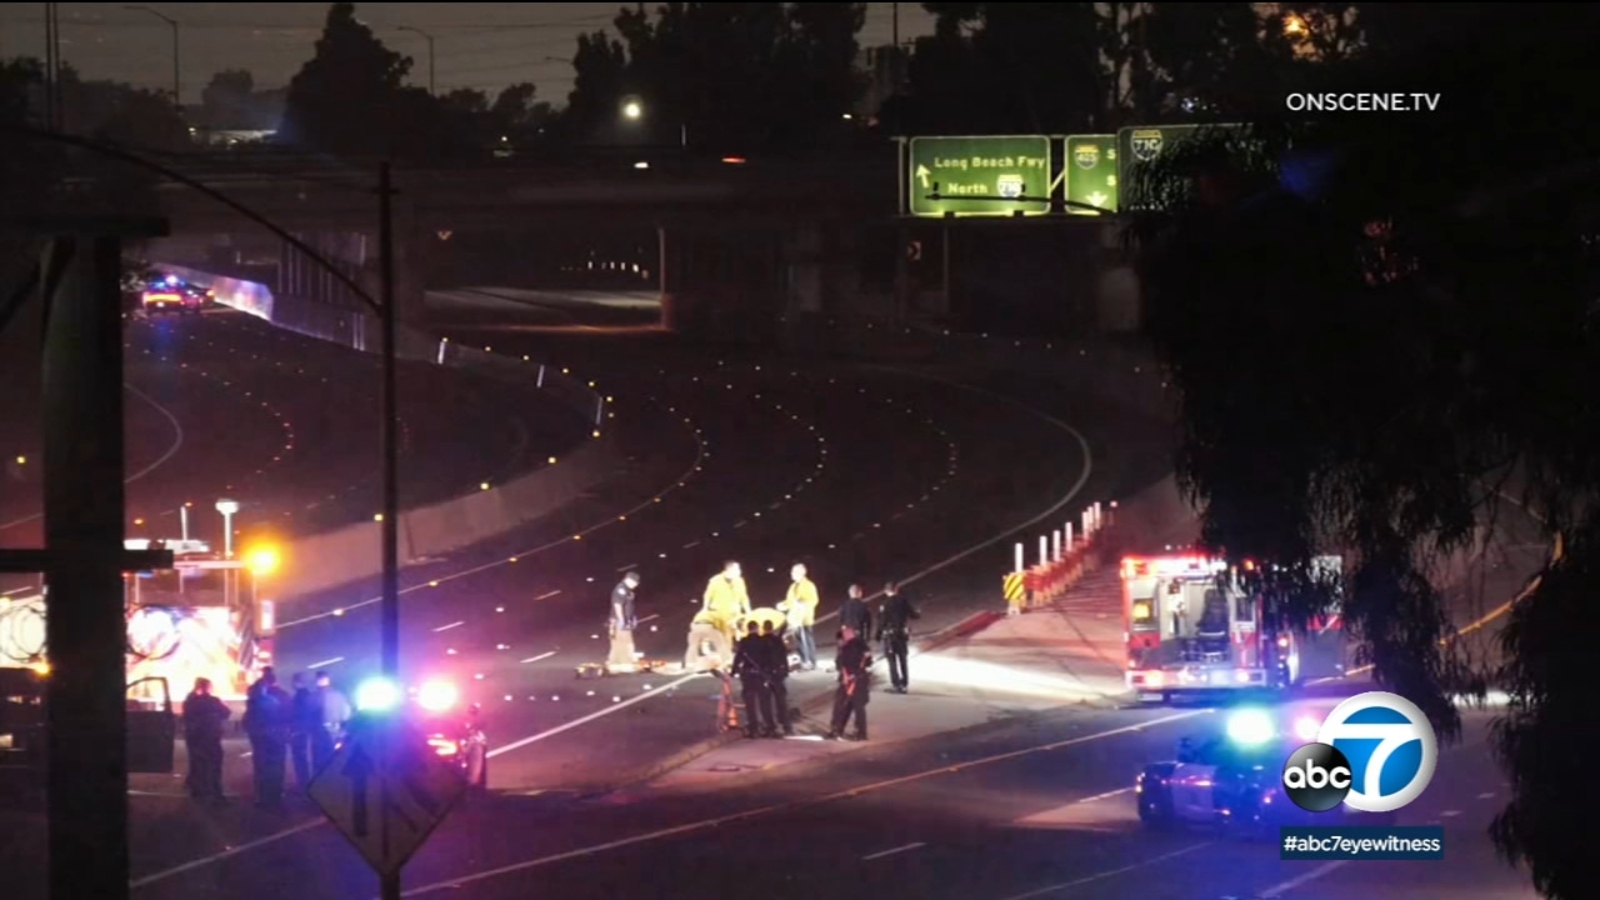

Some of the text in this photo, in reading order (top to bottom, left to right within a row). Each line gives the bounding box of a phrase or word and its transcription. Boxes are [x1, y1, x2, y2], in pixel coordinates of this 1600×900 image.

[934, 155, 1046, 170] Long Beach Fwy
[947, 183, 988, 194] North
